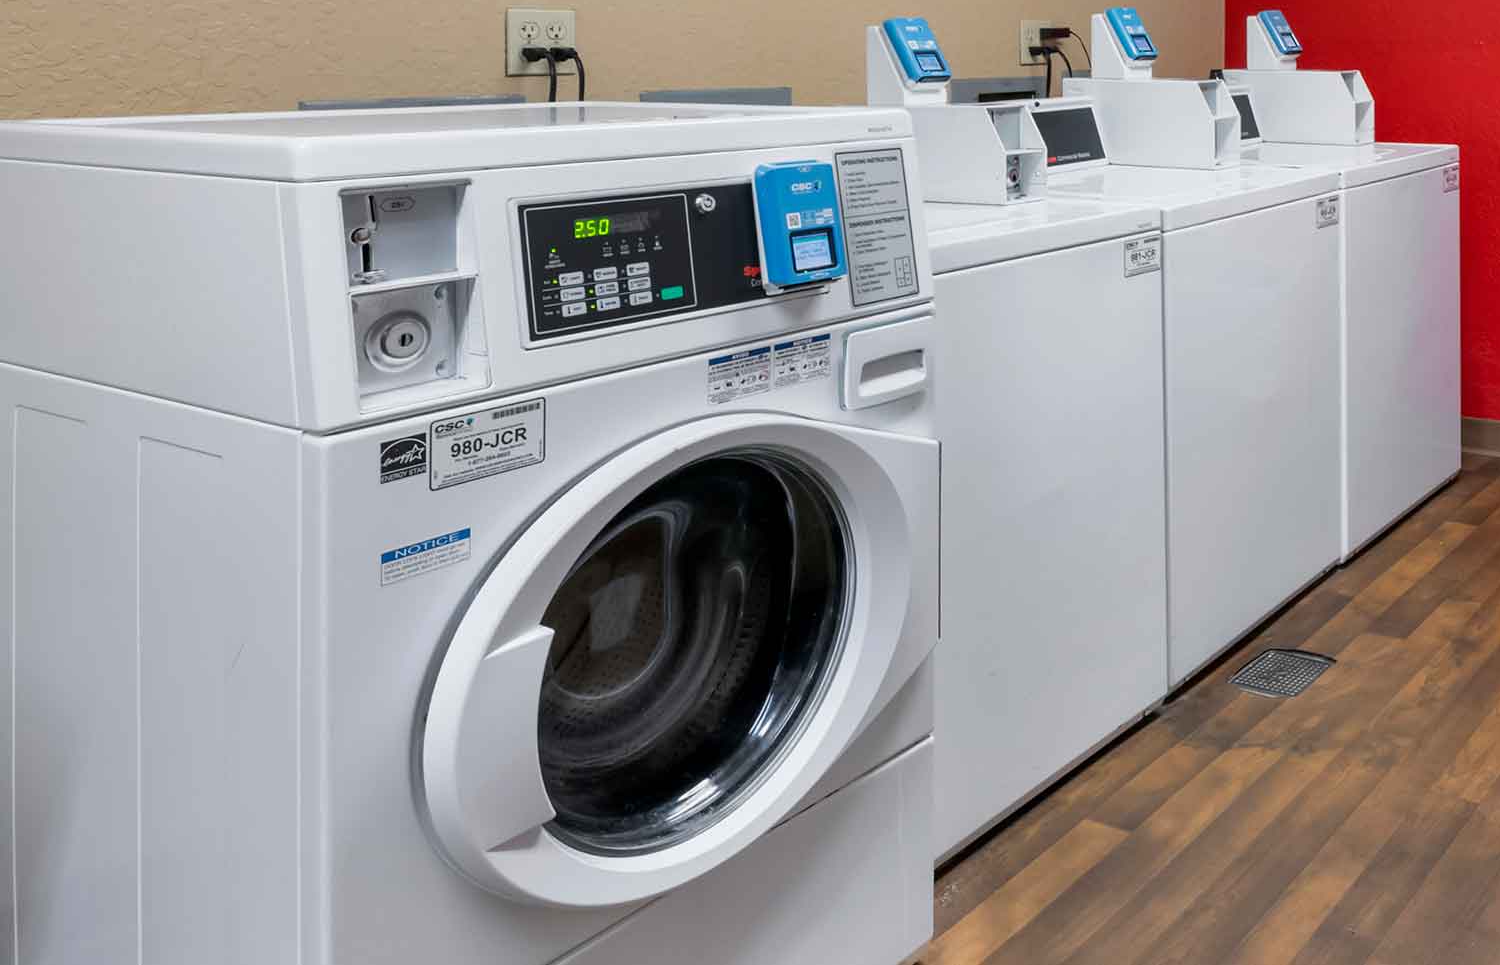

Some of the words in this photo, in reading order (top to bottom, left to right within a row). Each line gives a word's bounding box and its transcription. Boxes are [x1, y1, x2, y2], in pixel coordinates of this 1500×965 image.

[574, 218, 610, 239] 2.50
[435, 420, 465, 434] CSC
[450, 427, 528, 458] 980-JCR
[381, 470, 408, 484] ENERGY
[394, 534, 459, 559] NOTICE
